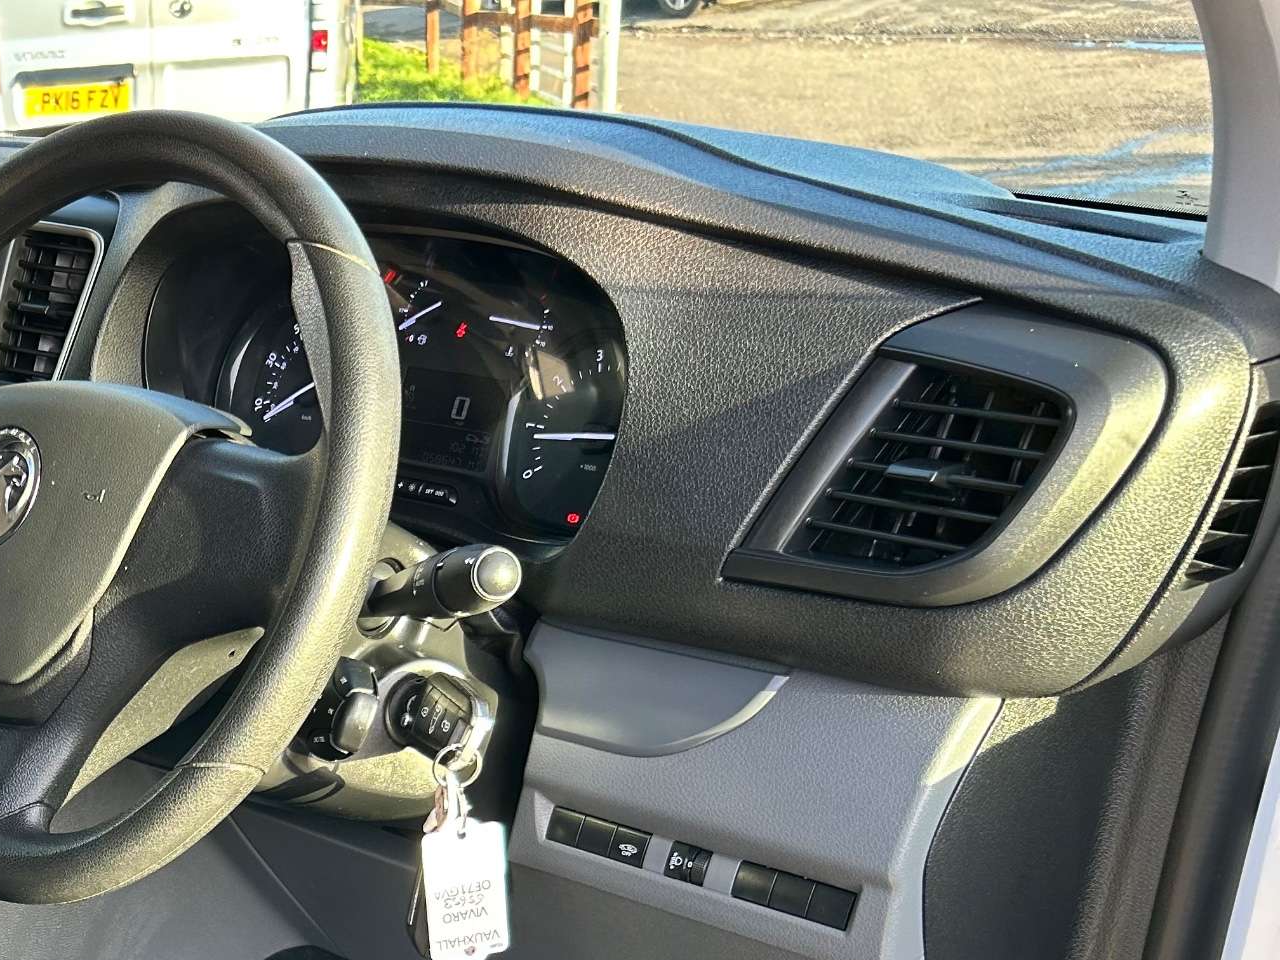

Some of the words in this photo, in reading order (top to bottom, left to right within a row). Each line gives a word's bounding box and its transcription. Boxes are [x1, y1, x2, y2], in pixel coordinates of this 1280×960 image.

[41, 90, 80, 113] PK16
[265, 352, 277, 368] 30
[596, 349, 603, 362] 3
[254, 397, 263, 412] 10
[450, 396, 471, 421] 0
[522, 468, 533, 480] 0
[442, 906, 489, 925] VIVARO
[435, 929, 501, 952] VAUXHALL
